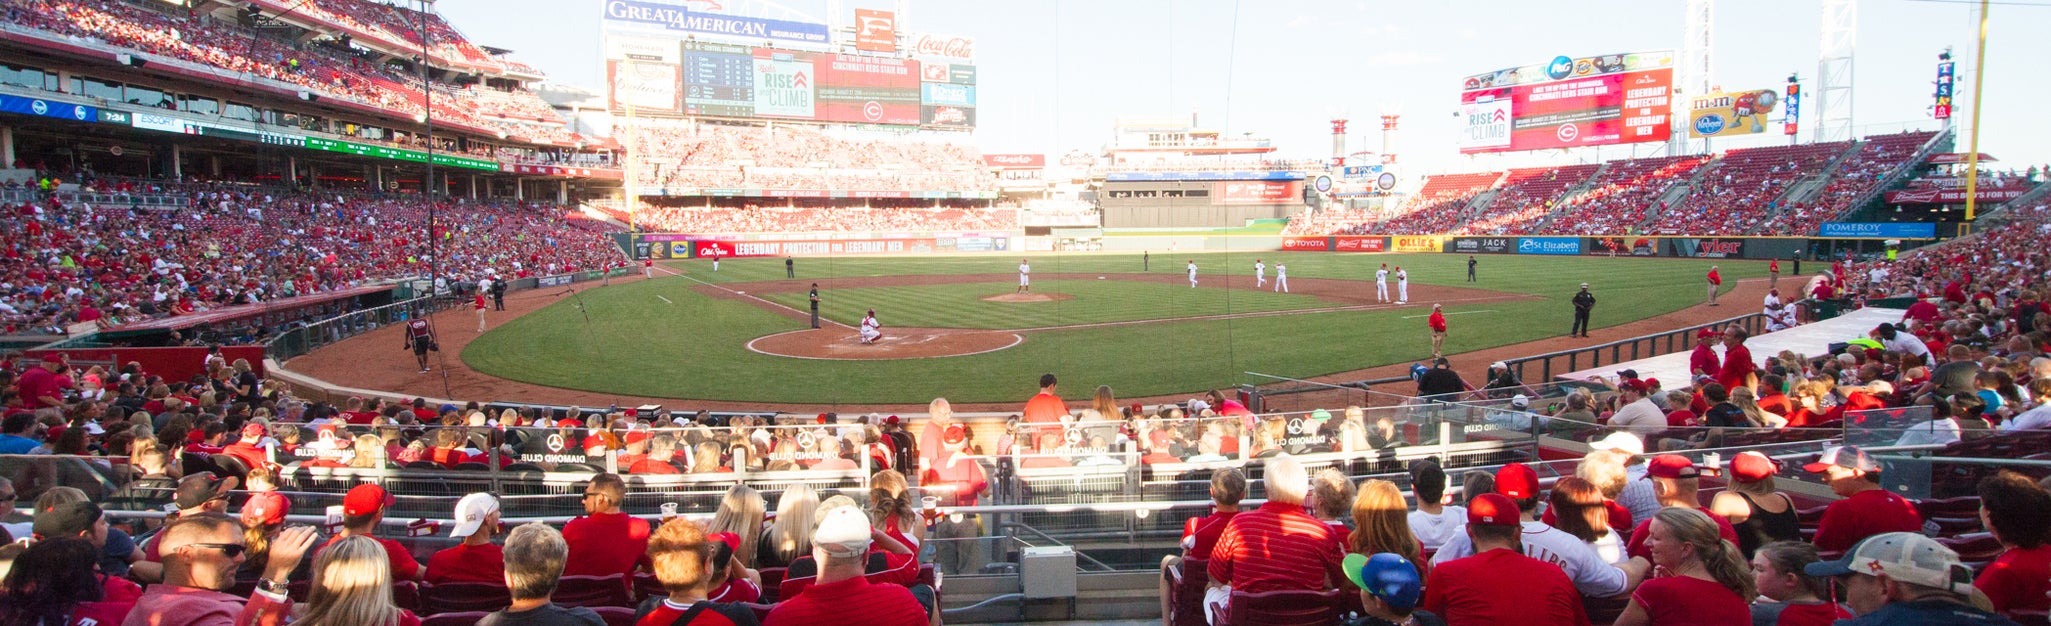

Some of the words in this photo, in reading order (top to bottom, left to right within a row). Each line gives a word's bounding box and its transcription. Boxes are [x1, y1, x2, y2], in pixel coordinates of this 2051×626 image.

[607, 1, 676, 23] GREAT
[670, 15, 767, 36] AMERICAN
[770, 30, 804, 40] INSURANCE
[805, 32, 825, 42] GROUP
[1551, 61, 1571, 74] P&G
[765, 72, 793, 89] RISE
[769, 88, 808, 108] CLIMB
[1529, 91, 1561, 102] CINCINNATI
[1577, 87, 1594, 97] STAIR
[1595, 85, 1608, 95] RUN
[1627, 86, 1667, 99] LEGENDARY
[1625, 96, 1668, 109] PROTECTION
[140, 114, 177, 127] ESCORT
[1469, 112, 1493, 126] RISE
[1626, 114, 1665, 127] LEGENDARY
[1697, 117, 1722, 132] Kroger
[1472, 123, 1505, 141] CLIMB
[1637, 126, 1652, 136] MEN
[1826, 223, 1882, 232] POMEROY
[735, 243, 780, 255] LEGENDARY
[783, 242, 829, 254] PROTECTION
[831, 243, 843, 252] FOR
[845, 241, 885, 253] LEGENDARY
[888, 241, 904, 252] MEN
[1399, 237, 1435, 248] OLLIE'S
[1482, 239, 1506, 247] JACK
[1533, 241, 1541, 249] St
[1543, 241, 1579, 249] Elizabeth
[701, 247, 713, 255] Old
[712, 247, 728, 256] Spice
